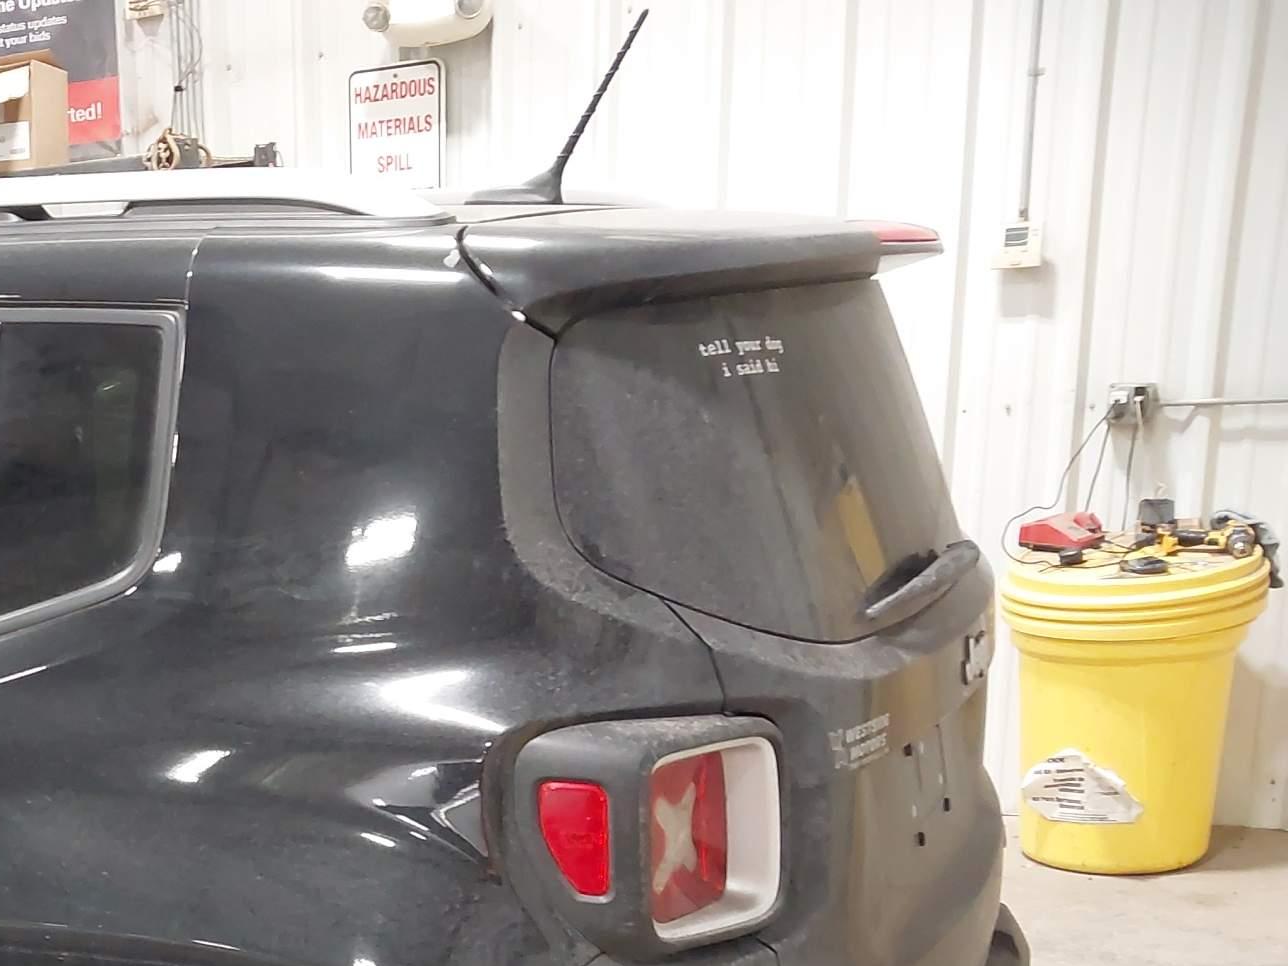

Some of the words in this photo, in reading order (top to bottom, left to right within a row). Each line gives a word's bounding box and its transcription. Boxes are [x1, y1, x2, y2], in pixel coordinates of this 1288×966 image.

[354, 76, 435, 105] HAZARDOUS
[67, 101, 102, 122] ted!
[357, 113, 433, 140] MATERIALS
[377, 152, 413, 174] SPILL
[698, 339, 732, 357] tell
[735, 360, 764, 375] said
